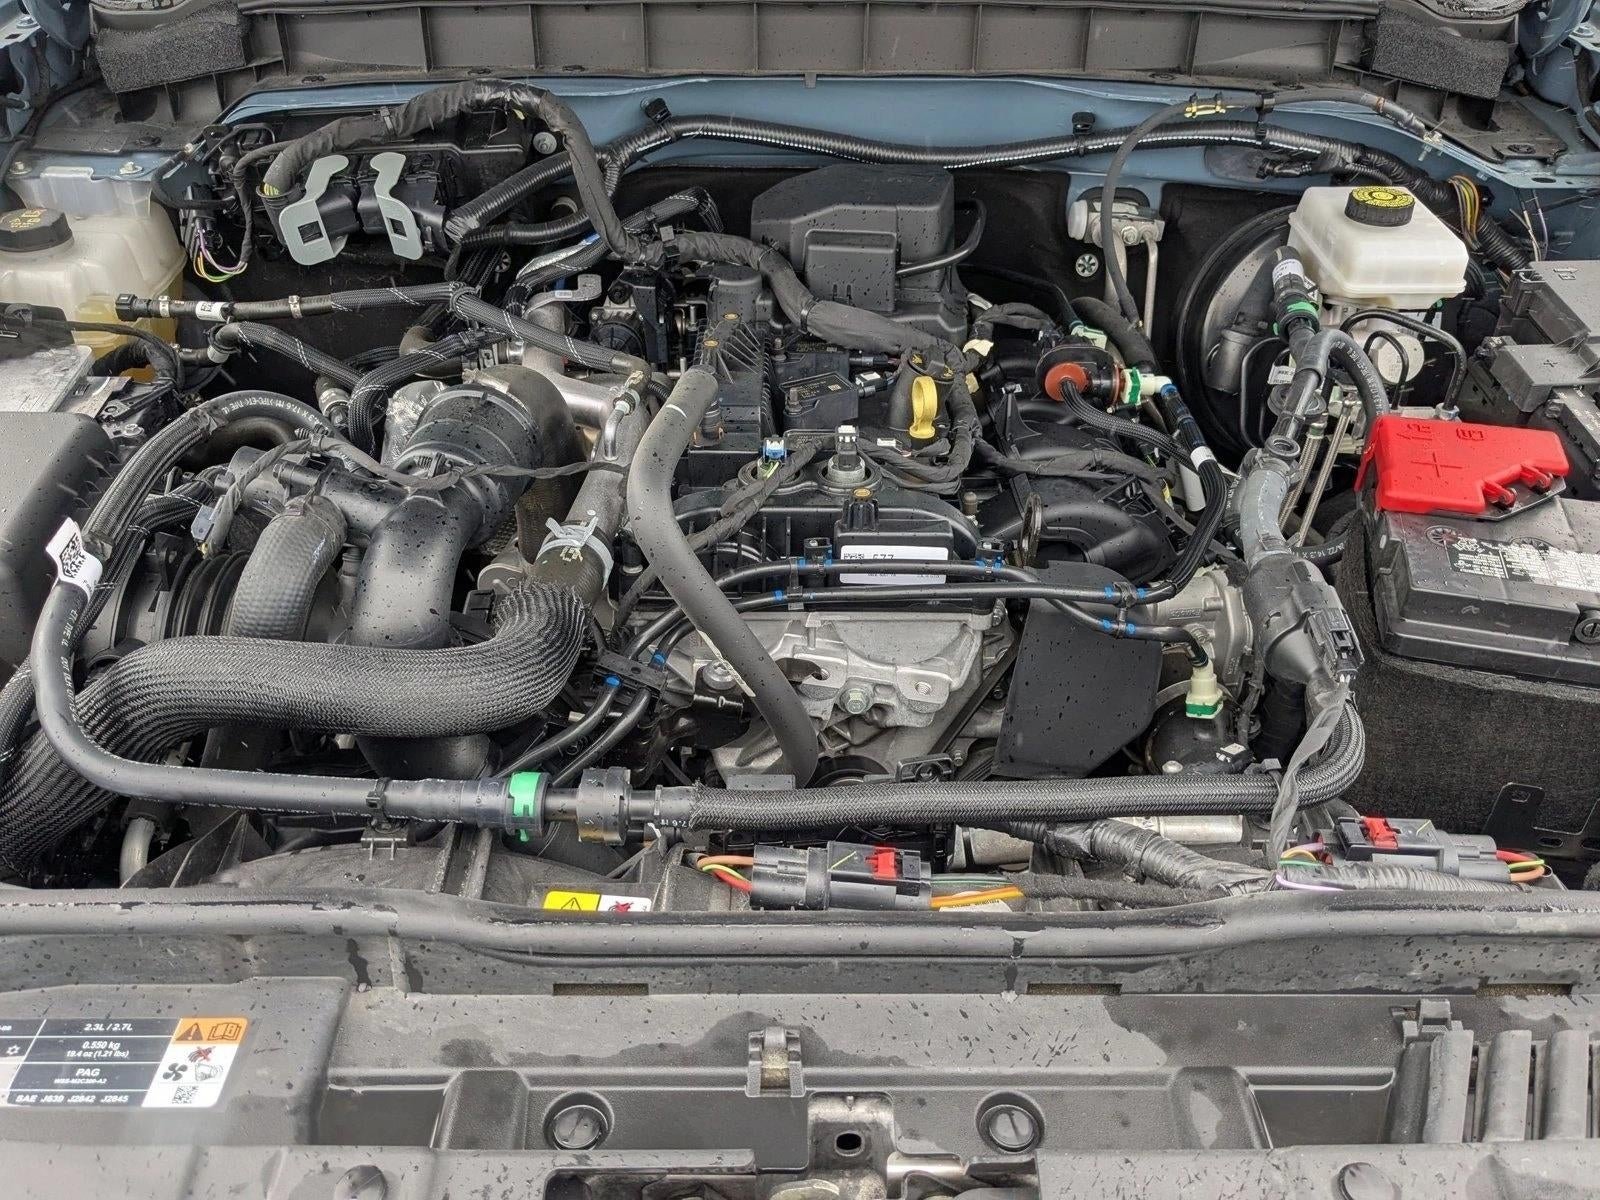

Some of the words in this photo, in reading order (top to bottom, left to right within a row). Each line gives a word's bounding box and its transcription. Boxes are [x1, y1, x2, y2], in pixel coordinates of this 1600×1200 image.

[84, 1023, 105, 1031] 2.3L
[112, 1022, 133, 1031] 2.7L
[82, 1041, 106, 1050] 0.550
[107, 1041, 121, 1050] kg
[114, 1050, 130, 1058] lbs)
[75, 1068, 101, 1077] PAG
[15, 1094, 38, 1103] SAE
[40, 1094, 65, 1103] J639
[100, 1094, 129, 1103] J2845
